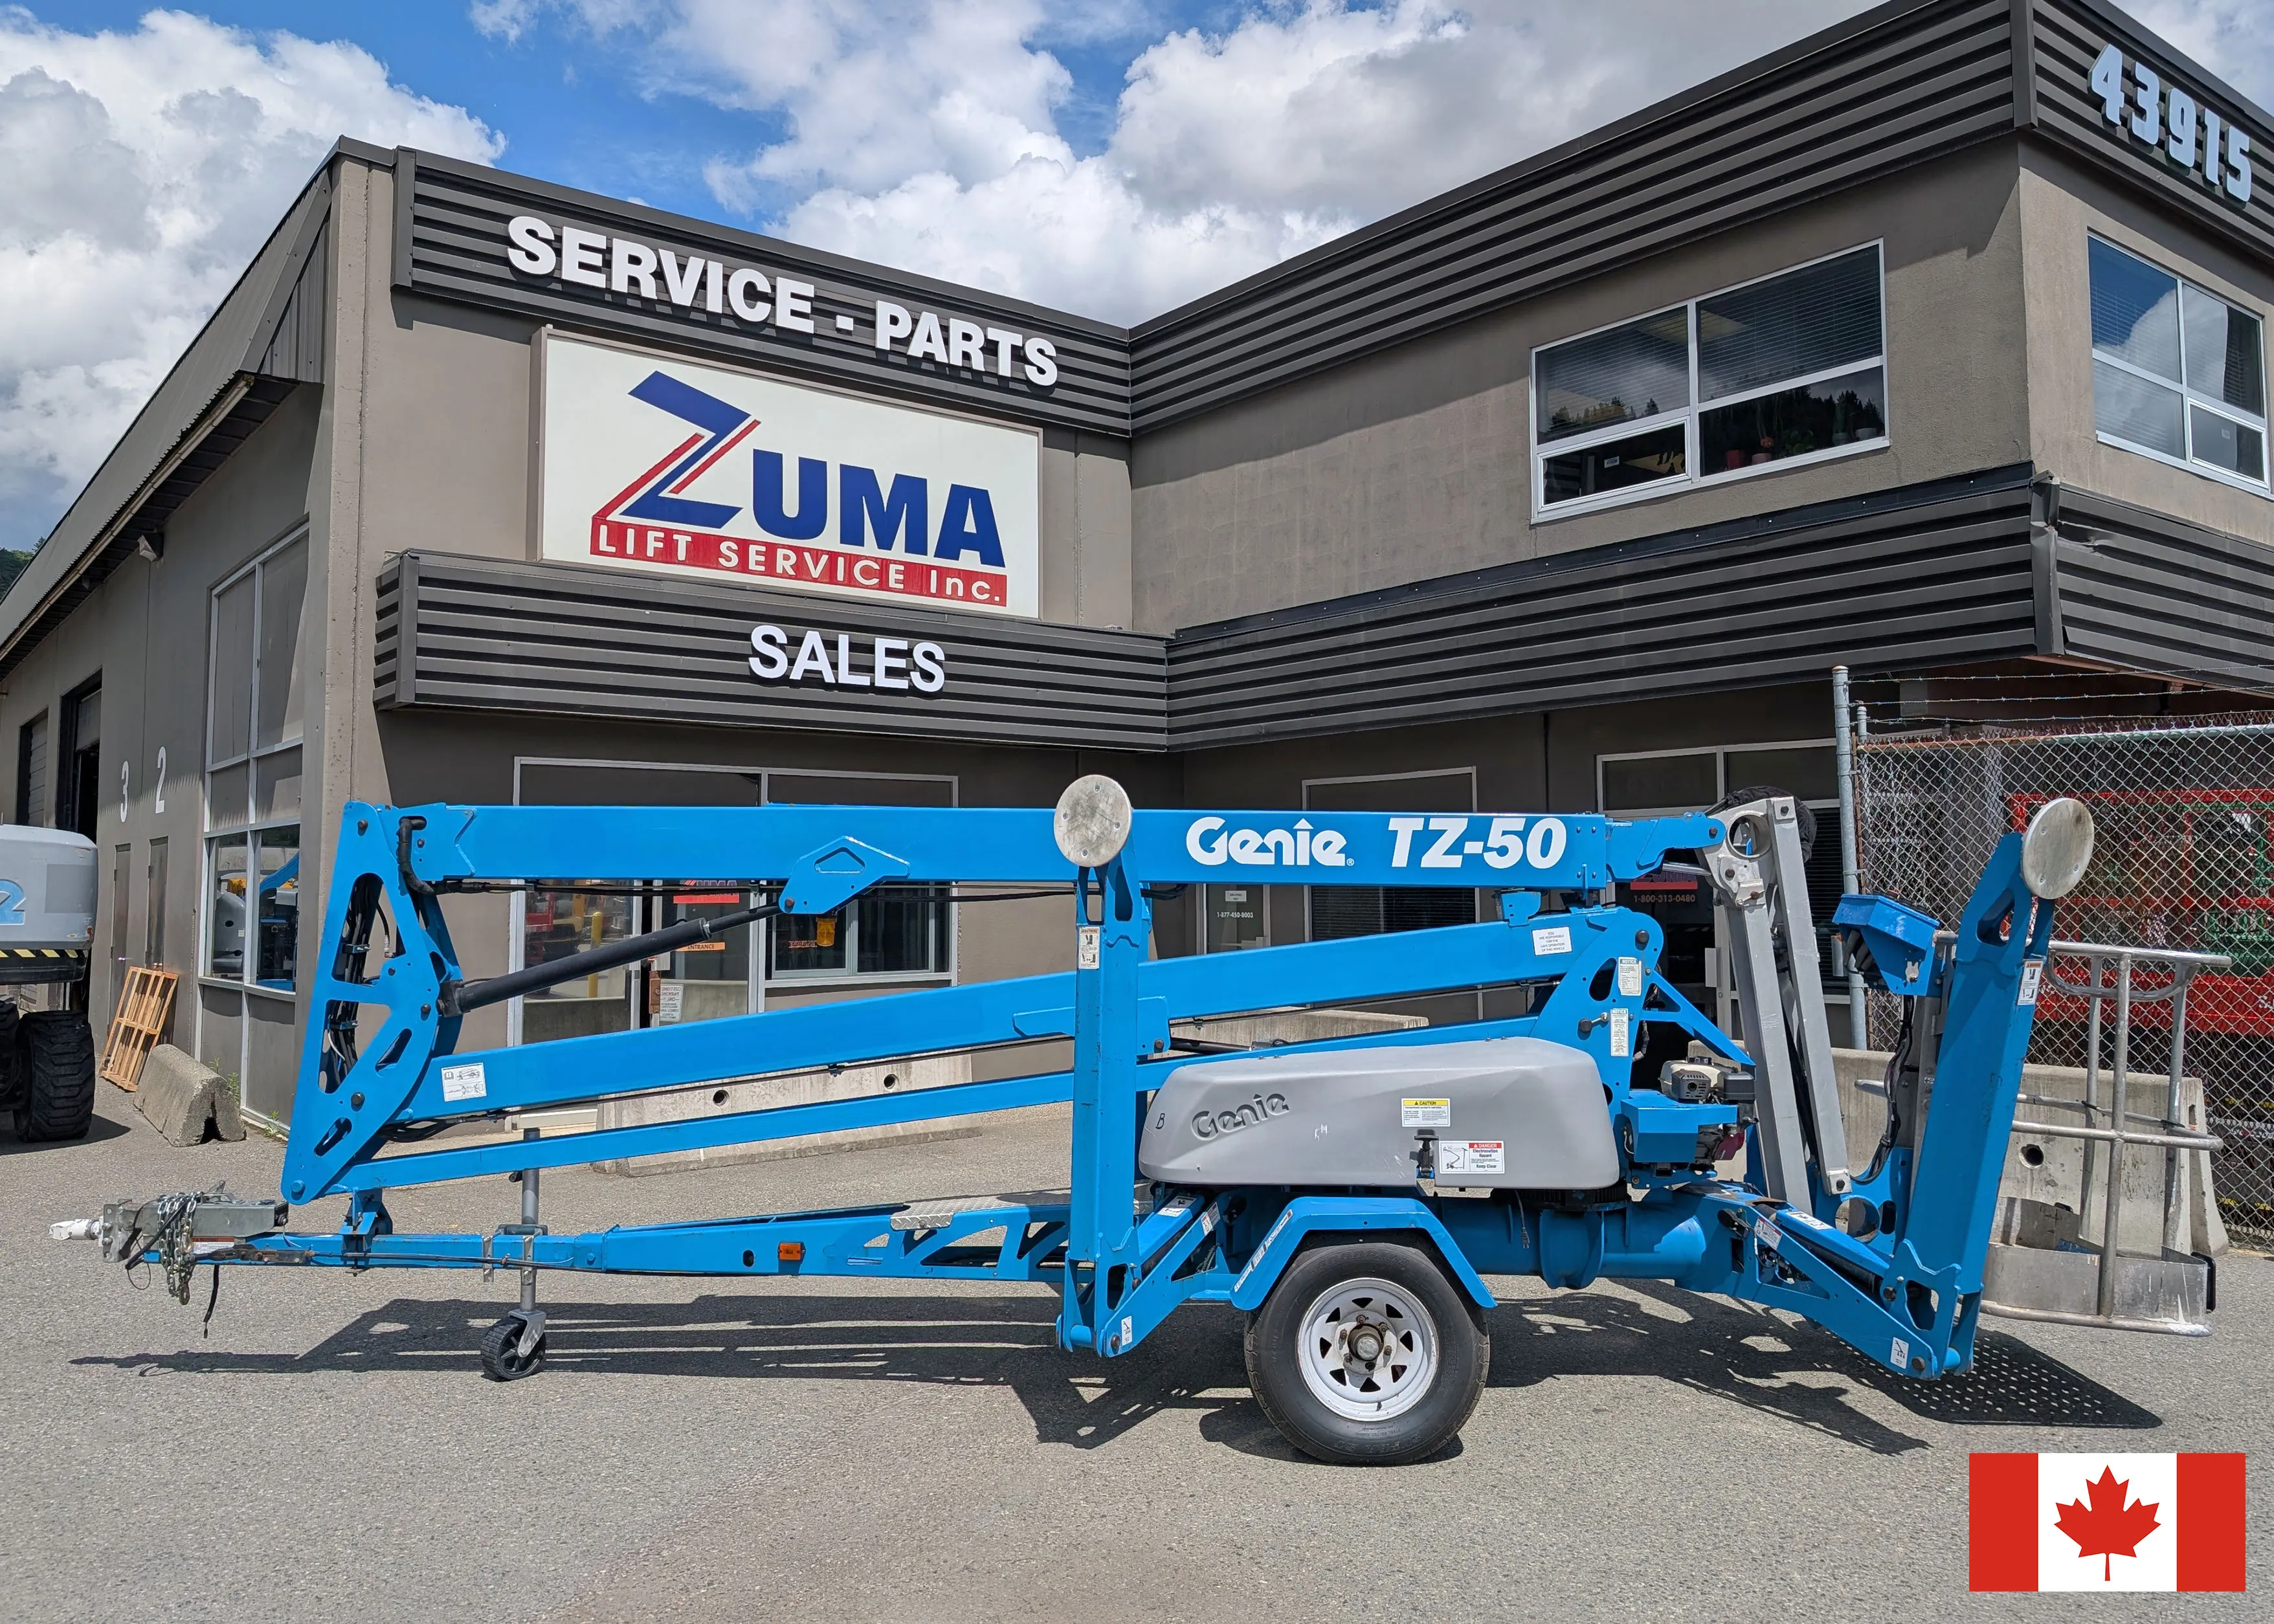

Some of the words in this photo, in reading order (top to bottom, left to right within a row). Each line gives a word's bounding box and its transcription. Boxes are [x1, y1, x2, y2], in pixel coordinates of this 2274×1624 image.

[2088, 43, 2252, 203] 43915
[507, 216, 815, 334] SERVICE
[875, 300, 1058, 386] PARTS
[618, 370, 1006, 568] ZUMA
[599, 524, 692, 561] LIFT
[718, 540, 905, 590] SERVICE
[930, 569, 1000, 602] Inc.
[748, 625, 945, 693] SALES
[120, 761, 129, 823] 3
[155, 746, 166, 814] 2
[1186, 816, 1346, 867] Genie
[1387, 817, 1567, 869] TZ-50
[1633, 894, 1695, 903] 1-800-313-0480
[1191, 1093, 1290, 1141] Genie
